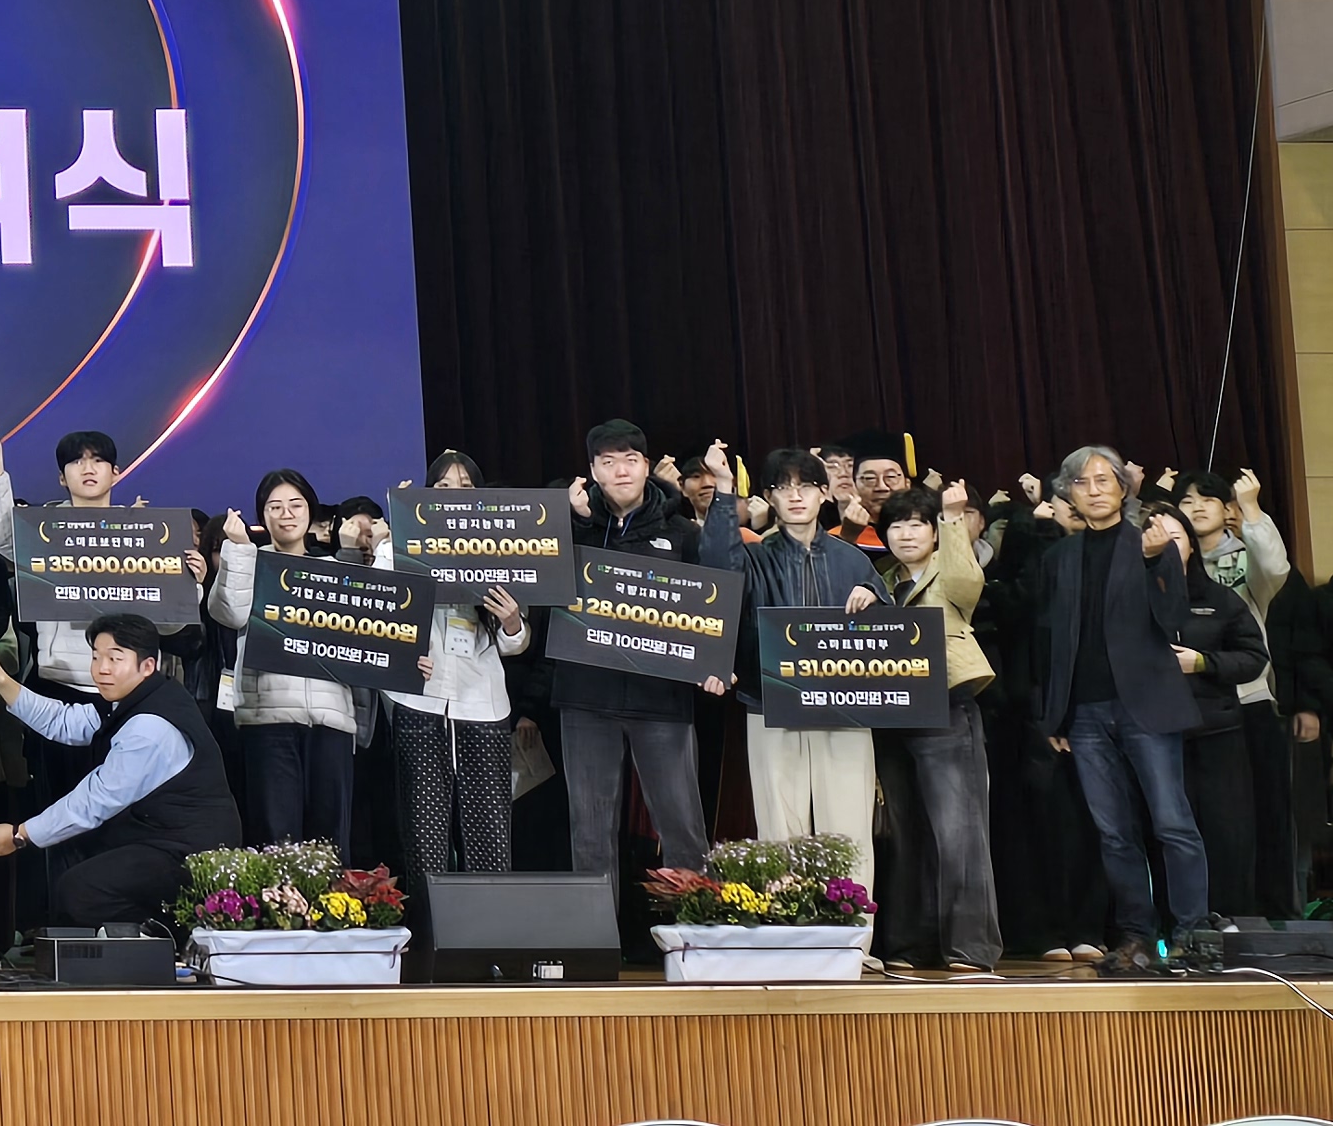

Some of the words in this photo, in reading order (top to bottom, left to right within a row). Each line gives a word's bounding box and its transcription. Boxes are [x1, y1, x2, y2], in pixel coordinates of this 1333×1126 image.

[425, 537, 559, 557] 35,000,000원
[49, 555, 182, 574] 35,000,000원
[512, 569, 537, 583] 지급
[135, 587, 161, 601] 지급
[282, 605, 418, 643] 30,000,000원
[586, 597, 723, 637] 28,000,000원
[363, 650, 390, 668] 지급
[669, 642, 695, 660] 지급
[798, 658, 930, 678] 31,000,000원
[884, 691, 910, 706] 지급
